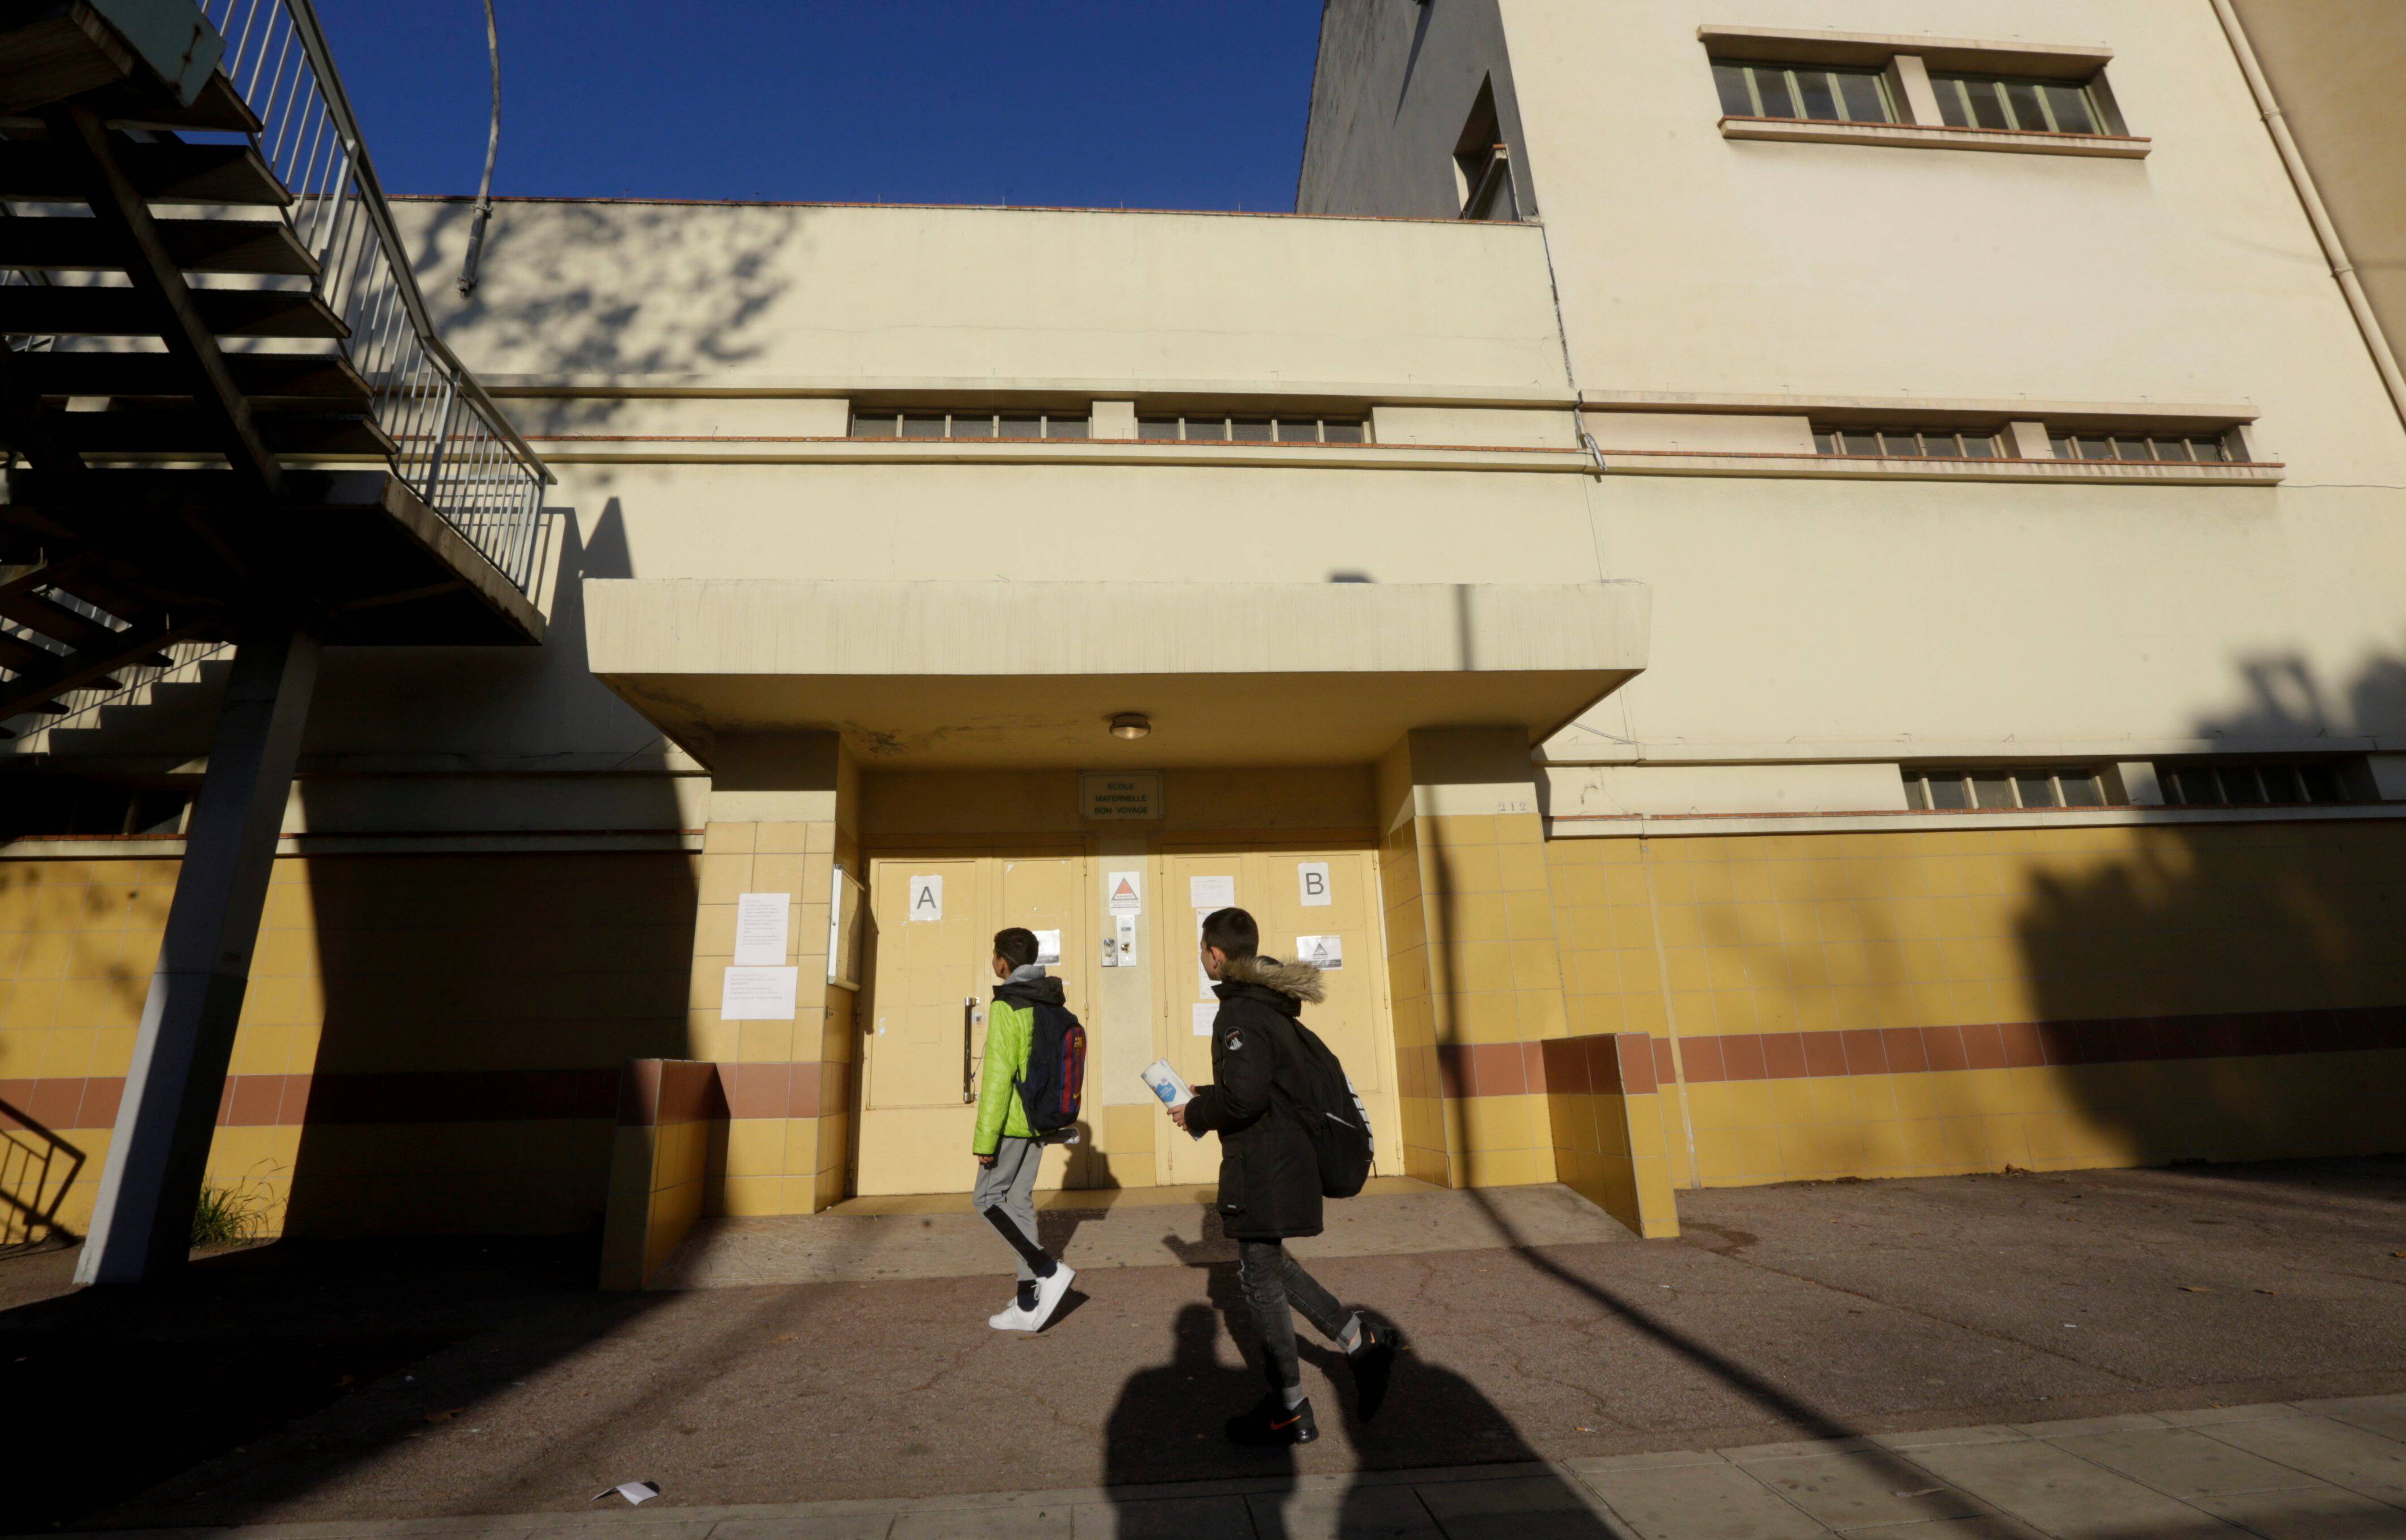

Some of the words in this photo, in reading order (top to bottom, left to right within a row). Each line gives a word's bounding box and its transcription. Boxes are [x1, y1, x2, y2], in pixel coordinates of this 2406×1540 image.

[1498, 802, 1527, 812] 212
[1305, 872, 1324, 896] B
[916, 886, 937, 909] A
